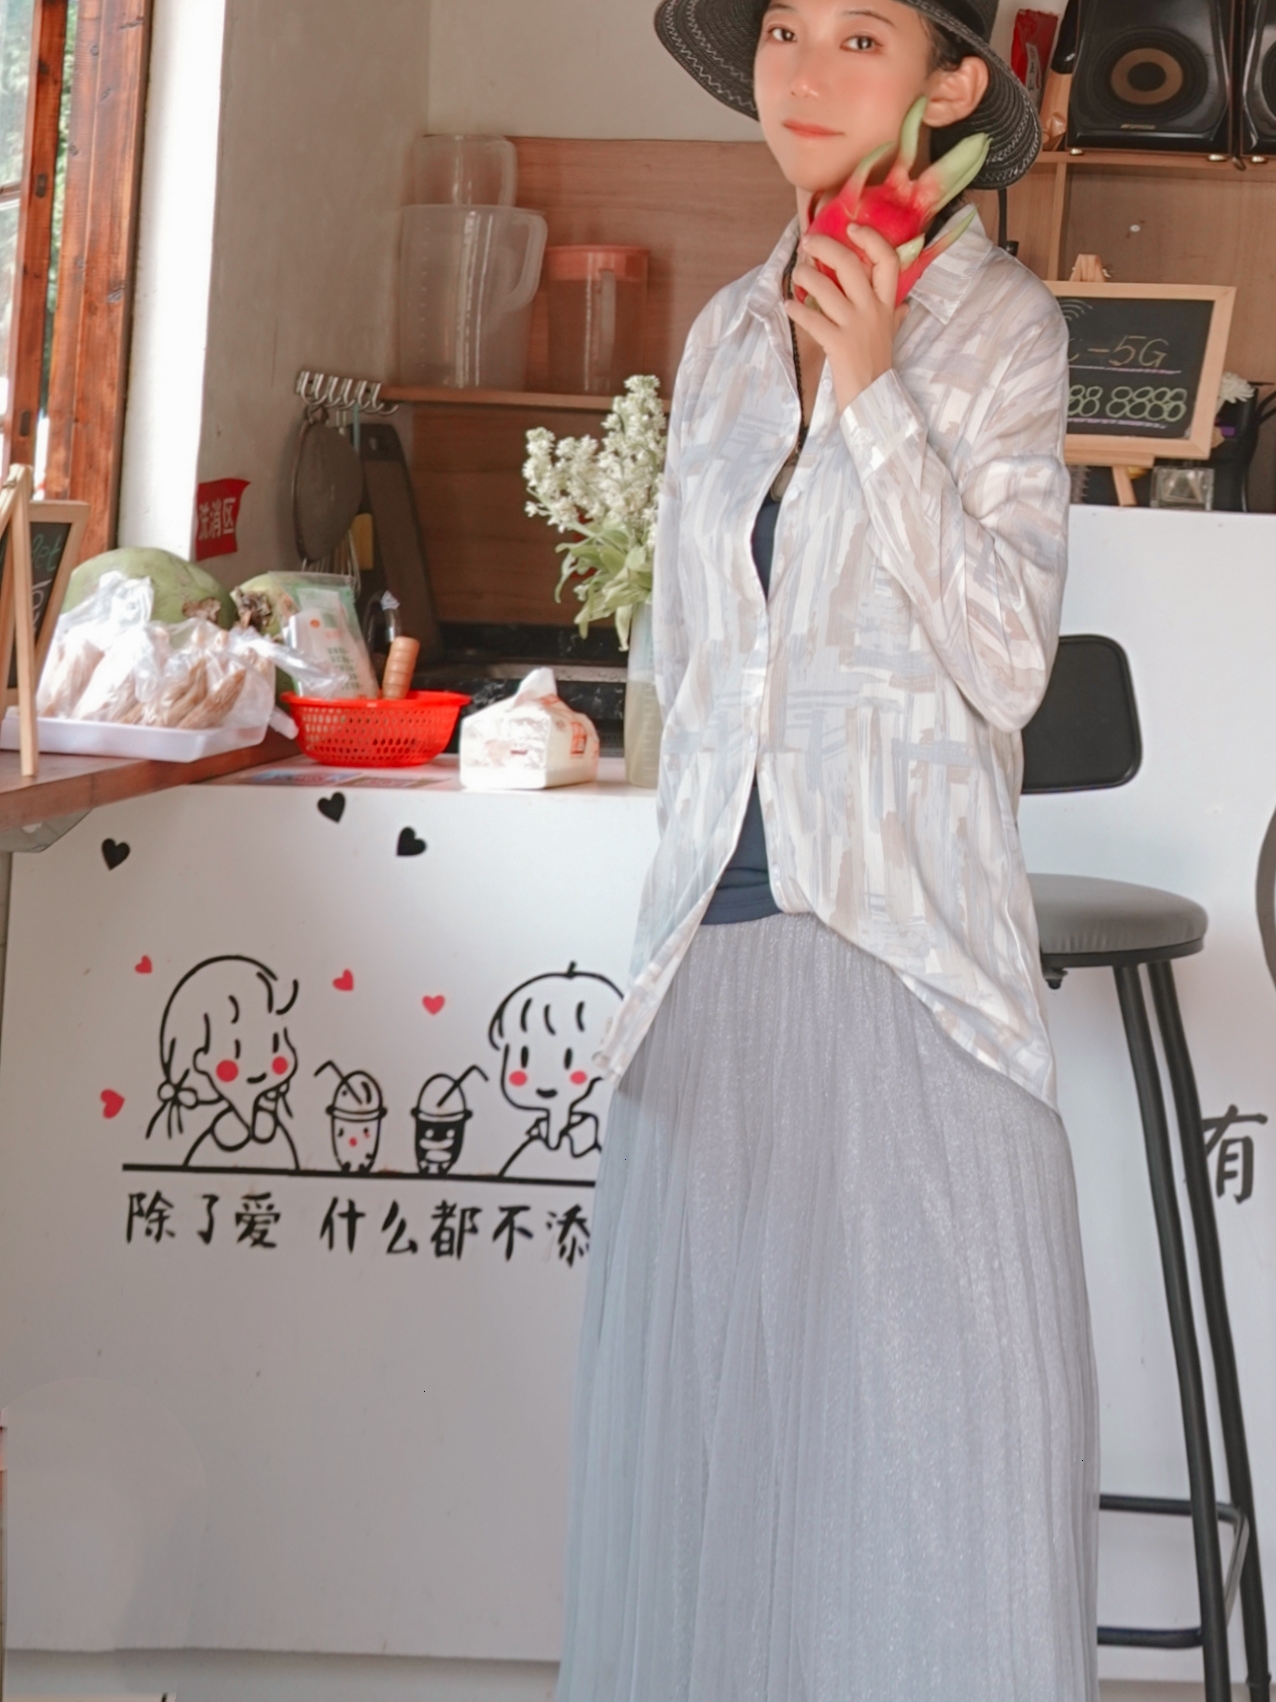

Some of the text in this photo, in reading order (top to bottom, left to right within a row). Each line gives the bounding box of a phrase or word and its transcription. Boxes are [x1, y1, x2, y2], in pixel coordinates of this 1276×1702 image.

[126, 1190, 591, 1269] 除了爱 什么都不添
